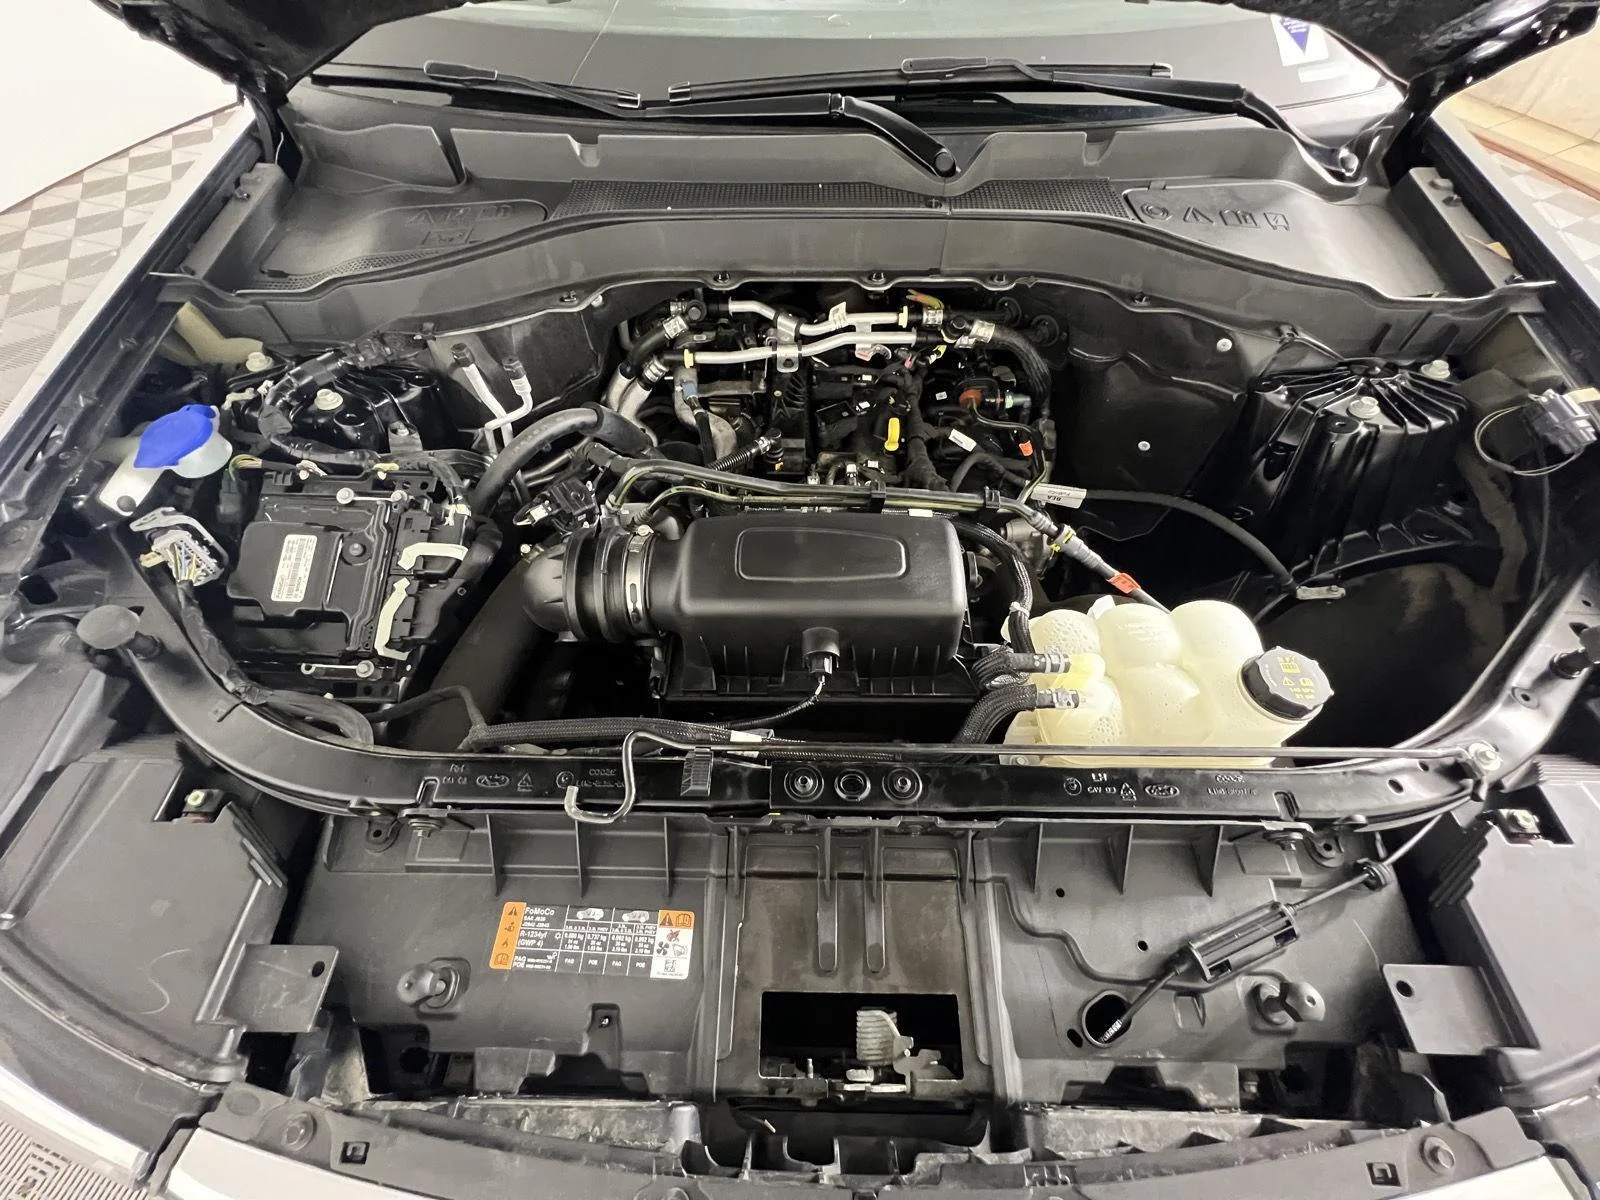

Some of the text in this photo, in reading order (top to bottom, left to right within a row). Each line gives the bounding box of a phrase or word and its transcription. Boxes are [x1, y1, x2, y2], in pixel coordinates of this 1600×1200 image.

[1091, 773, 1107, 782] LH
[525, 907, 555, 916] FoMoCo
[520, 930, 548, 939] R-1234yf
[518, 939, 537, 947] (GWP
